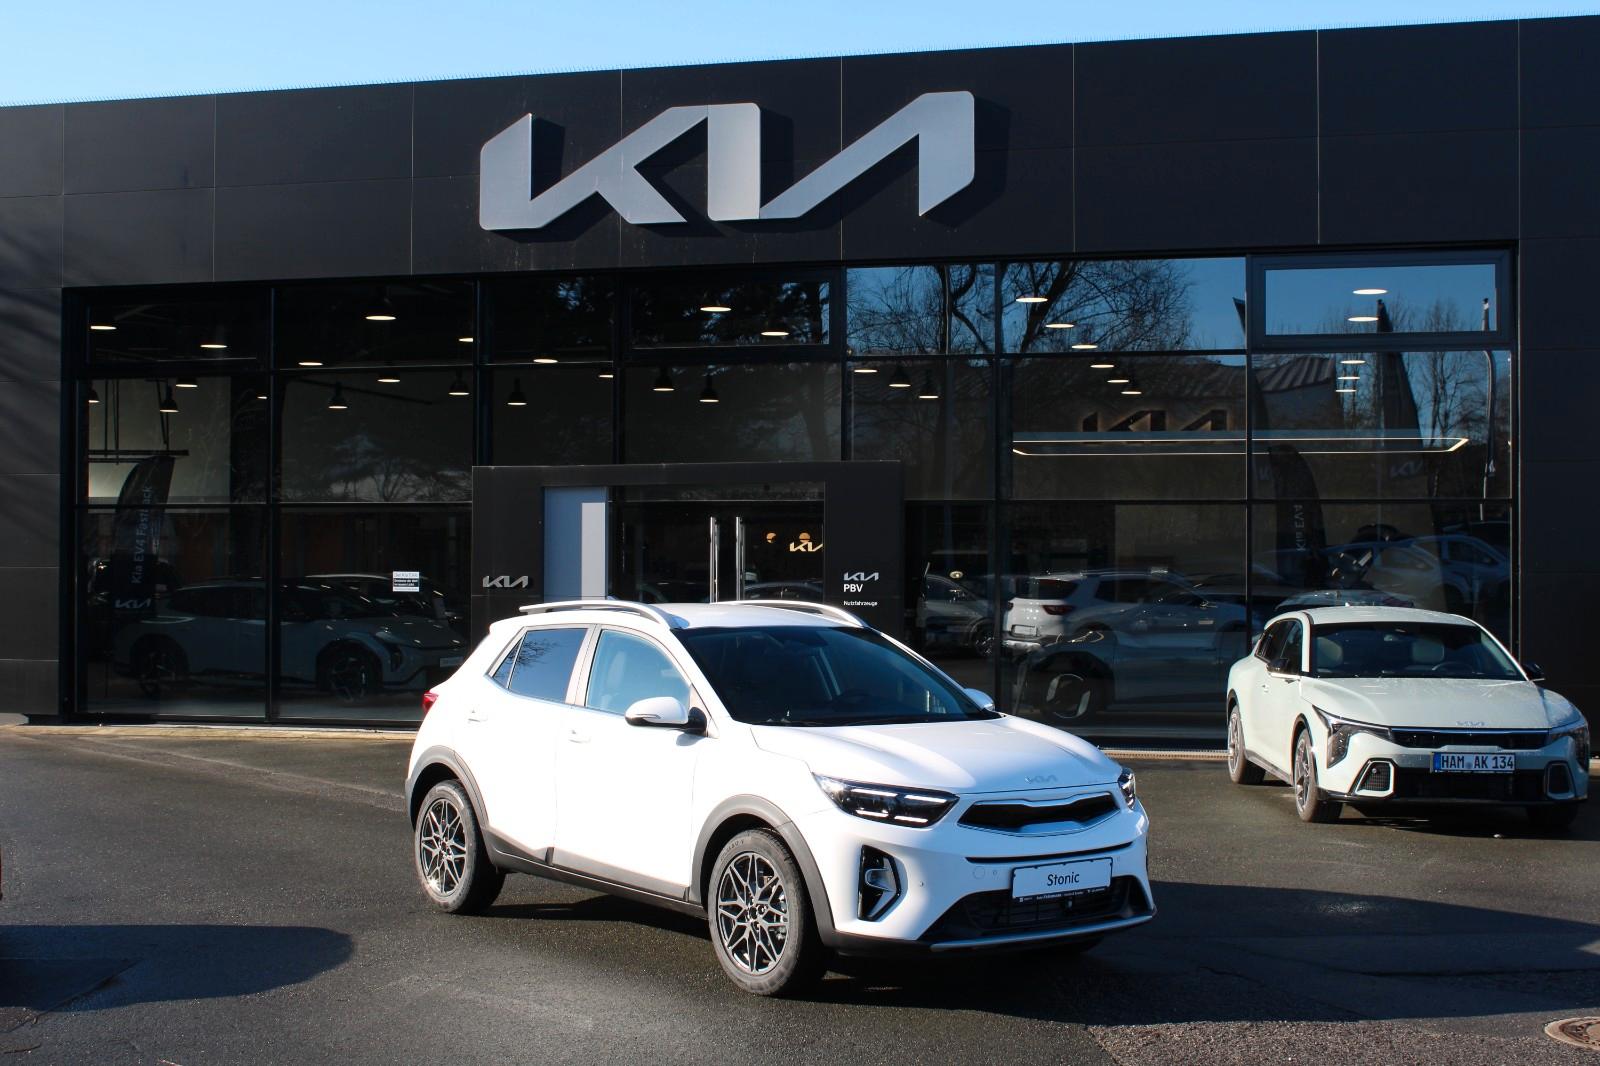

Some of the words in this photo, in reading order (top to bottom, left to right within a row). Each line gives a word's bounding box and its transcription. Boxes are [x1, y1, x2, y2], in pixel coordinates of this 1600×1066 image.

[479, 91, 976, 231] KIA
[136, 486, 152, 536] Fastack
[134, 538, 145, 562] EV4
[483, 575, 529, 588] KIA
[843, 572, 880, 581] KIA
[843, 584, 864, 593] PBV
[1442, 755, 1465, 769] HAM
[1474, 755, 1489, 769] AK
[1492, 755, 1514, 769] 134
[1046, 872, 1080, 887] Stonic
